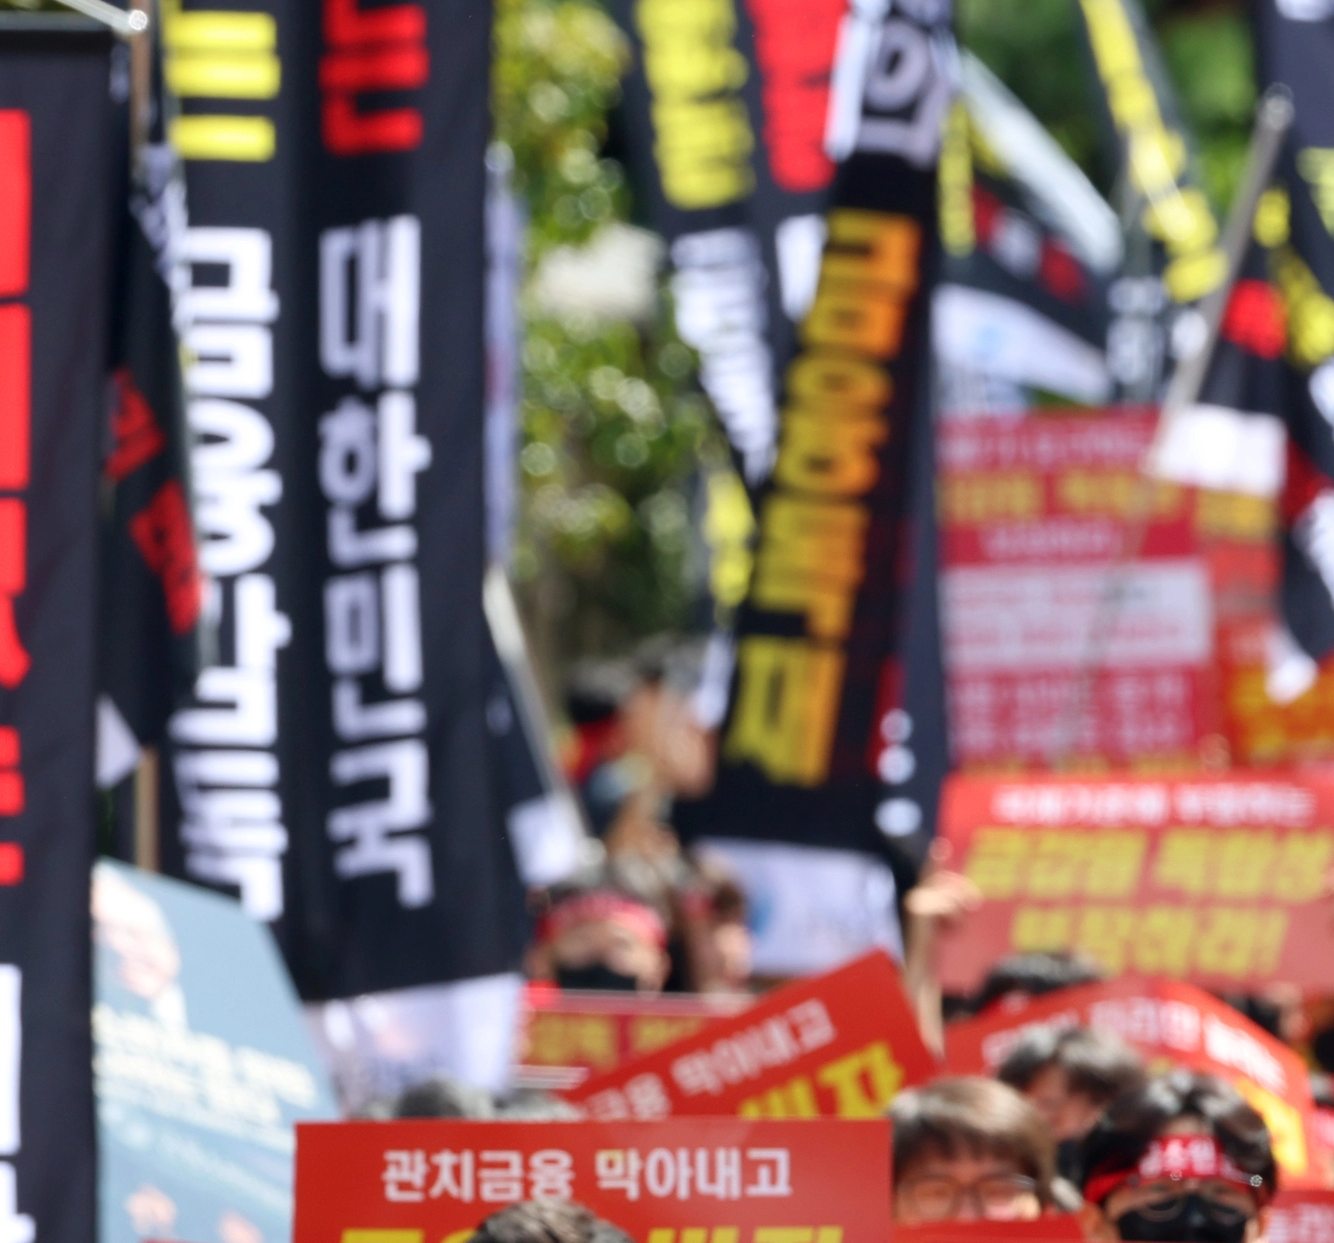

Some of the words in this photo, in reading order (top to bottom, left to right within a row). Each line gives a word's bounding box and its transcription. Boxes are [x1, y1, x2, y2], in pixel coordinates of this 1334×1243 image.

[317, 213, 434, 908] 대한민국
[670, 998, 837, 1098] 막아내고
[381, 1150, 576, 1203] 관치금융
[595, 1148, 793, 1202] 막아내고
